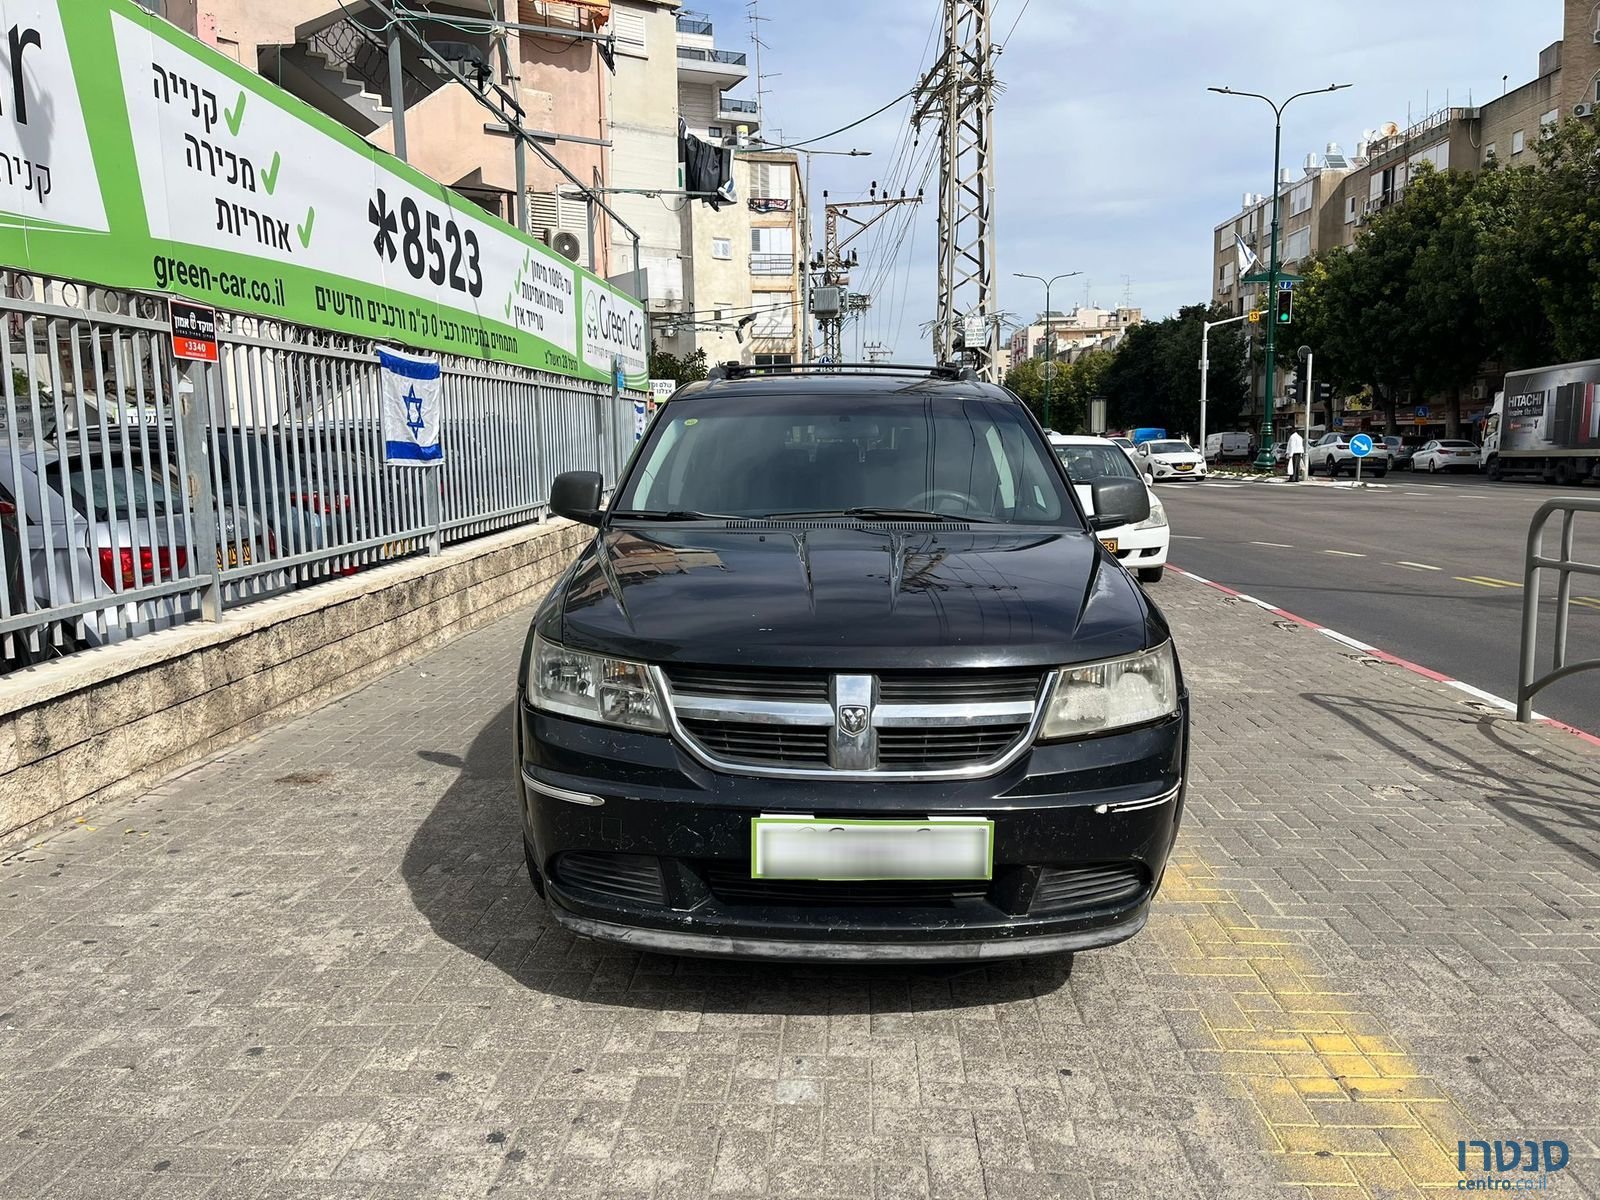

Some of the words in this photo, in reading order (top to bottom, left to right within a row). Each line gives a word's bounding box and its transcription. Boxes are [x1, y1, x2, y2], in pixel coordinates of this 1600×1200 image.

[0, 24, 42, 125] r
[152, 62, 218, 133] קנייה
[184, 132, 256, 193] מכירה
[215, 197, 292, 252] אחריות
[153, 254, 285, 307] green-car.co.il
[315, 285, 364, 320] חדשים
[197, 320, 213, 333] מוקד
[367, 299, 406, 330] ורכבים
[440, 320, 460, 342] רכבי
[599, 294, 628, 347] Green
[629, 309, 642, 352] Car
[1508, 393, 1542, 407] HITACHI
